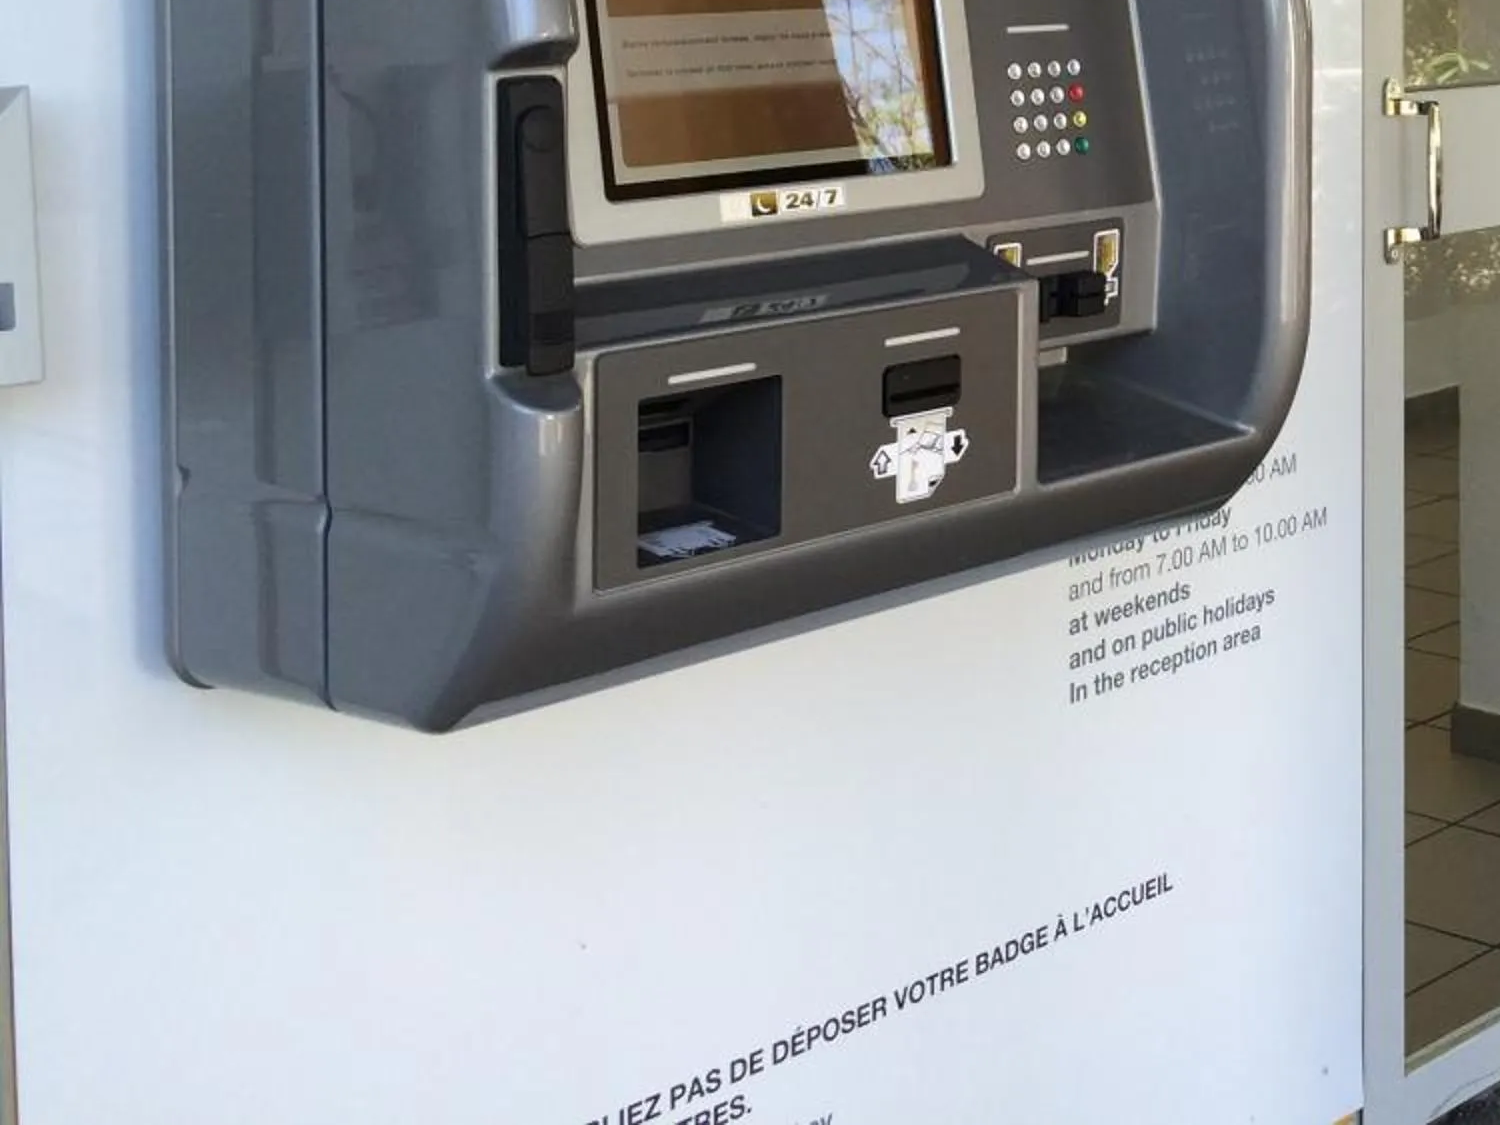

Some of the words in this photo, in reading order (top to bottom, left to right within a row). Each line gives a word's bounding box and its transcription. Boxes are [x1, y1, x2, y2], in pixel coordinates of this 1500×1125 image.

[785, 188, 838, 210] 24/7
[1268, 452, 1297, 481] AM
[1068, 576, 1103, 602] and
[1109, 562, 1151, 590] from
[1156, 546, 1194, 575] 7.00
[1199, 535, 1228, 564] AM
[1232, 534, 1249, 552] to
[1254, 516, 1298, 546] 10.00
[1300, 506, 1328, 533] AM
[1068, 611, 1089, 636] at
[1094, 581, 1191, 627] weekends
[1068, 638, 1106, 670] and
[1111, 633, 1137, 657] on
[1141, 613, 1198, 652] public
[1202, 587, 1276, 626] holidays
[1069, 682, 1088, 704] In
[1094, 671, 1125, 696] the
[1130, 638, 1218, 684] reception
[1222, 625, 1262, 652] area
[669, 1068, 722, 1110] PAS
[729, 1048, 765, 1084] DE
[771, 995, 889, 1066] DÉPOSER
[893, 960, 970, 1011] VOTRE
[974, 926, 1050, 977] BADGE
[1053, 913, 1068, 943] À
[1073, 871, 1174, 933] L'ACCUEIL
